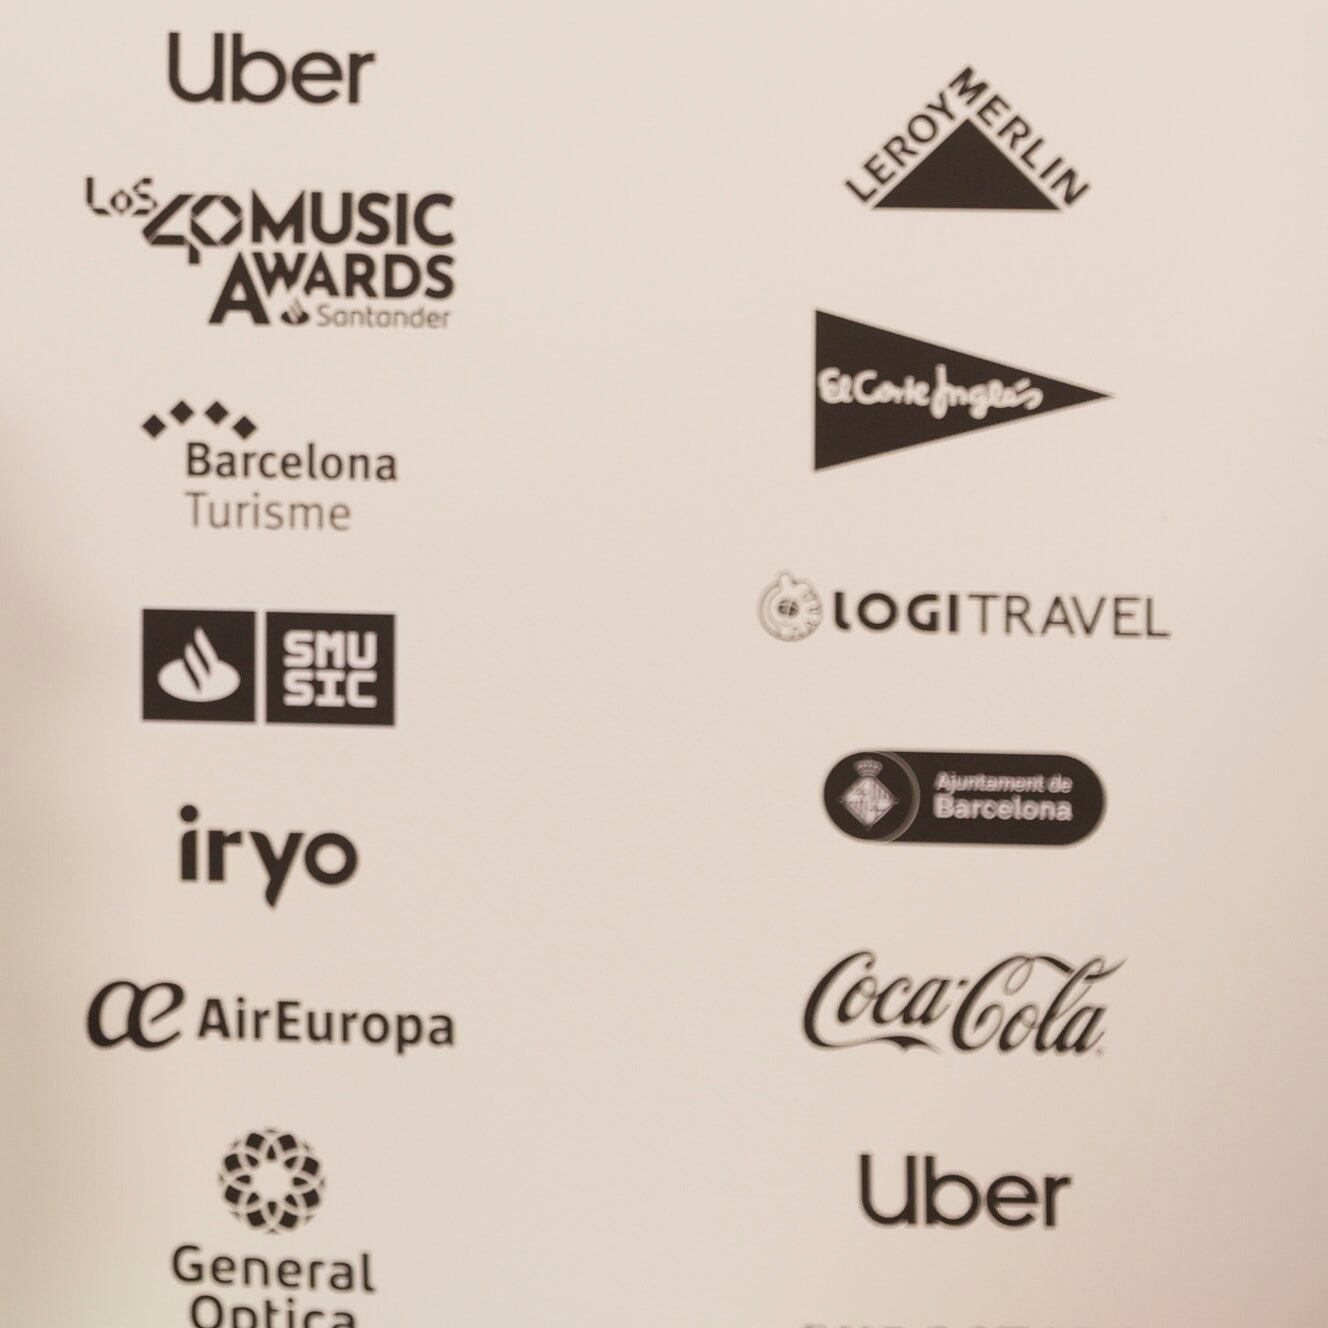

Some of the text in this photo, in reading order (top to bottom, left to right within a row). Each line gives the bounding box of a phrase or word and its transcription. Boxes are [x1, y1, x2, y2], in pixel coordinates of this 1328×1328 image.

[167, 31, 376, 105] Uber
[843, 90, 958, 205] LEROY
[946, 65, 1092, 208] MERLIN
[251, 190, 456, 248] MUSIC
[208, 250, 456, 325] AWARDS
[316, 304, 451, 330] Santander
[817, 363, 1044, 419] El Corte Inglés
[186, 442, 398, 483] Barcelona
[185, 491, 352, 532] Turisme
[832, 590, 1172, 640] LOGITRAVEL
[933, 793, 1073, 821] Barcelona
[934, 771, 1073, 794] Ajuntament de
[179, 804, 358, 910] iryo
[198, 996, 456, 1057] AirEuropa
[858, 1153, 1073, 1230] Uber
[172, 1243, 377, 1293] General
